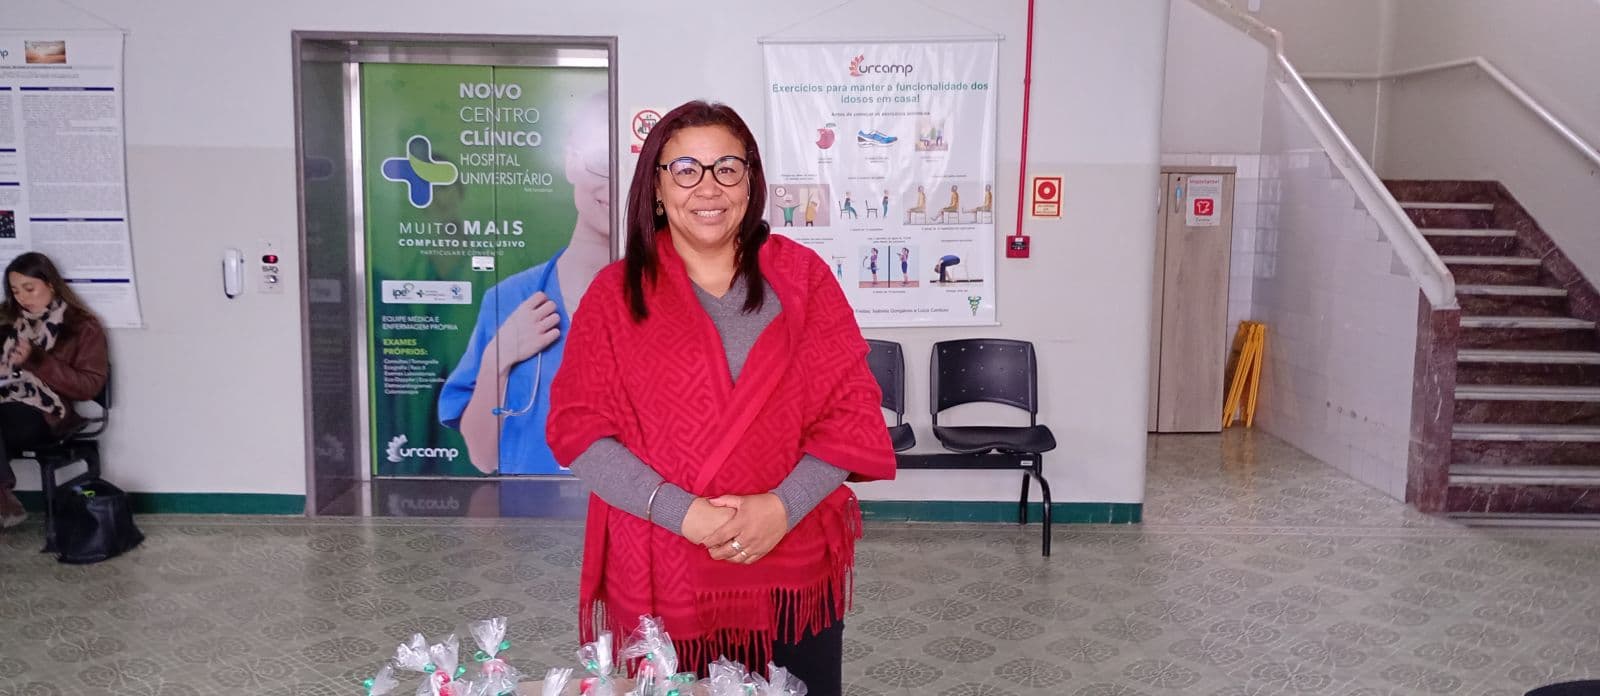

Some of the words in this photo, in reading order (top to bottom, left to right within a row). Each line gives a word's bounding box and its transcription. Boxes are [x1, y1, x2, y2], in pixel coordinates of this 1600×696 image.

[858, 64, 914, 77] urcamp
[459, 83, 522, 100] NOVO
[772, 83, 823, 93] Exercícios
[826, 84, 848, 95] para
[850, 83, 886, 92] manter
[896, 81, 968, 92] funcionalidade
[970, 81, 989, 90] dos
[841, 95, 874, 104] idosos
[894, 93, 920, 103] casa!
[459, 106, 540, 124] CENTRO
[460, 127, 542, 147] CLÍNICO
[460, 152, 521, 167] HOSPITAL
[460, 169, 553, 186] UNIVERSITÁRIO
[399, 222, 458, 235] MUITO
[463, 220, 524, 236] MAIS
[398, 238, 460, 248] COMPLETO
[462, 240, 469, 248] E
[470, 240, 526, 248] EXCLUSIVO
[383, 338, 416, 346] EXAMES
[383, 347, 428, 355] PRÓPRIOS:
[400, 447, 459, 461] urcamp
